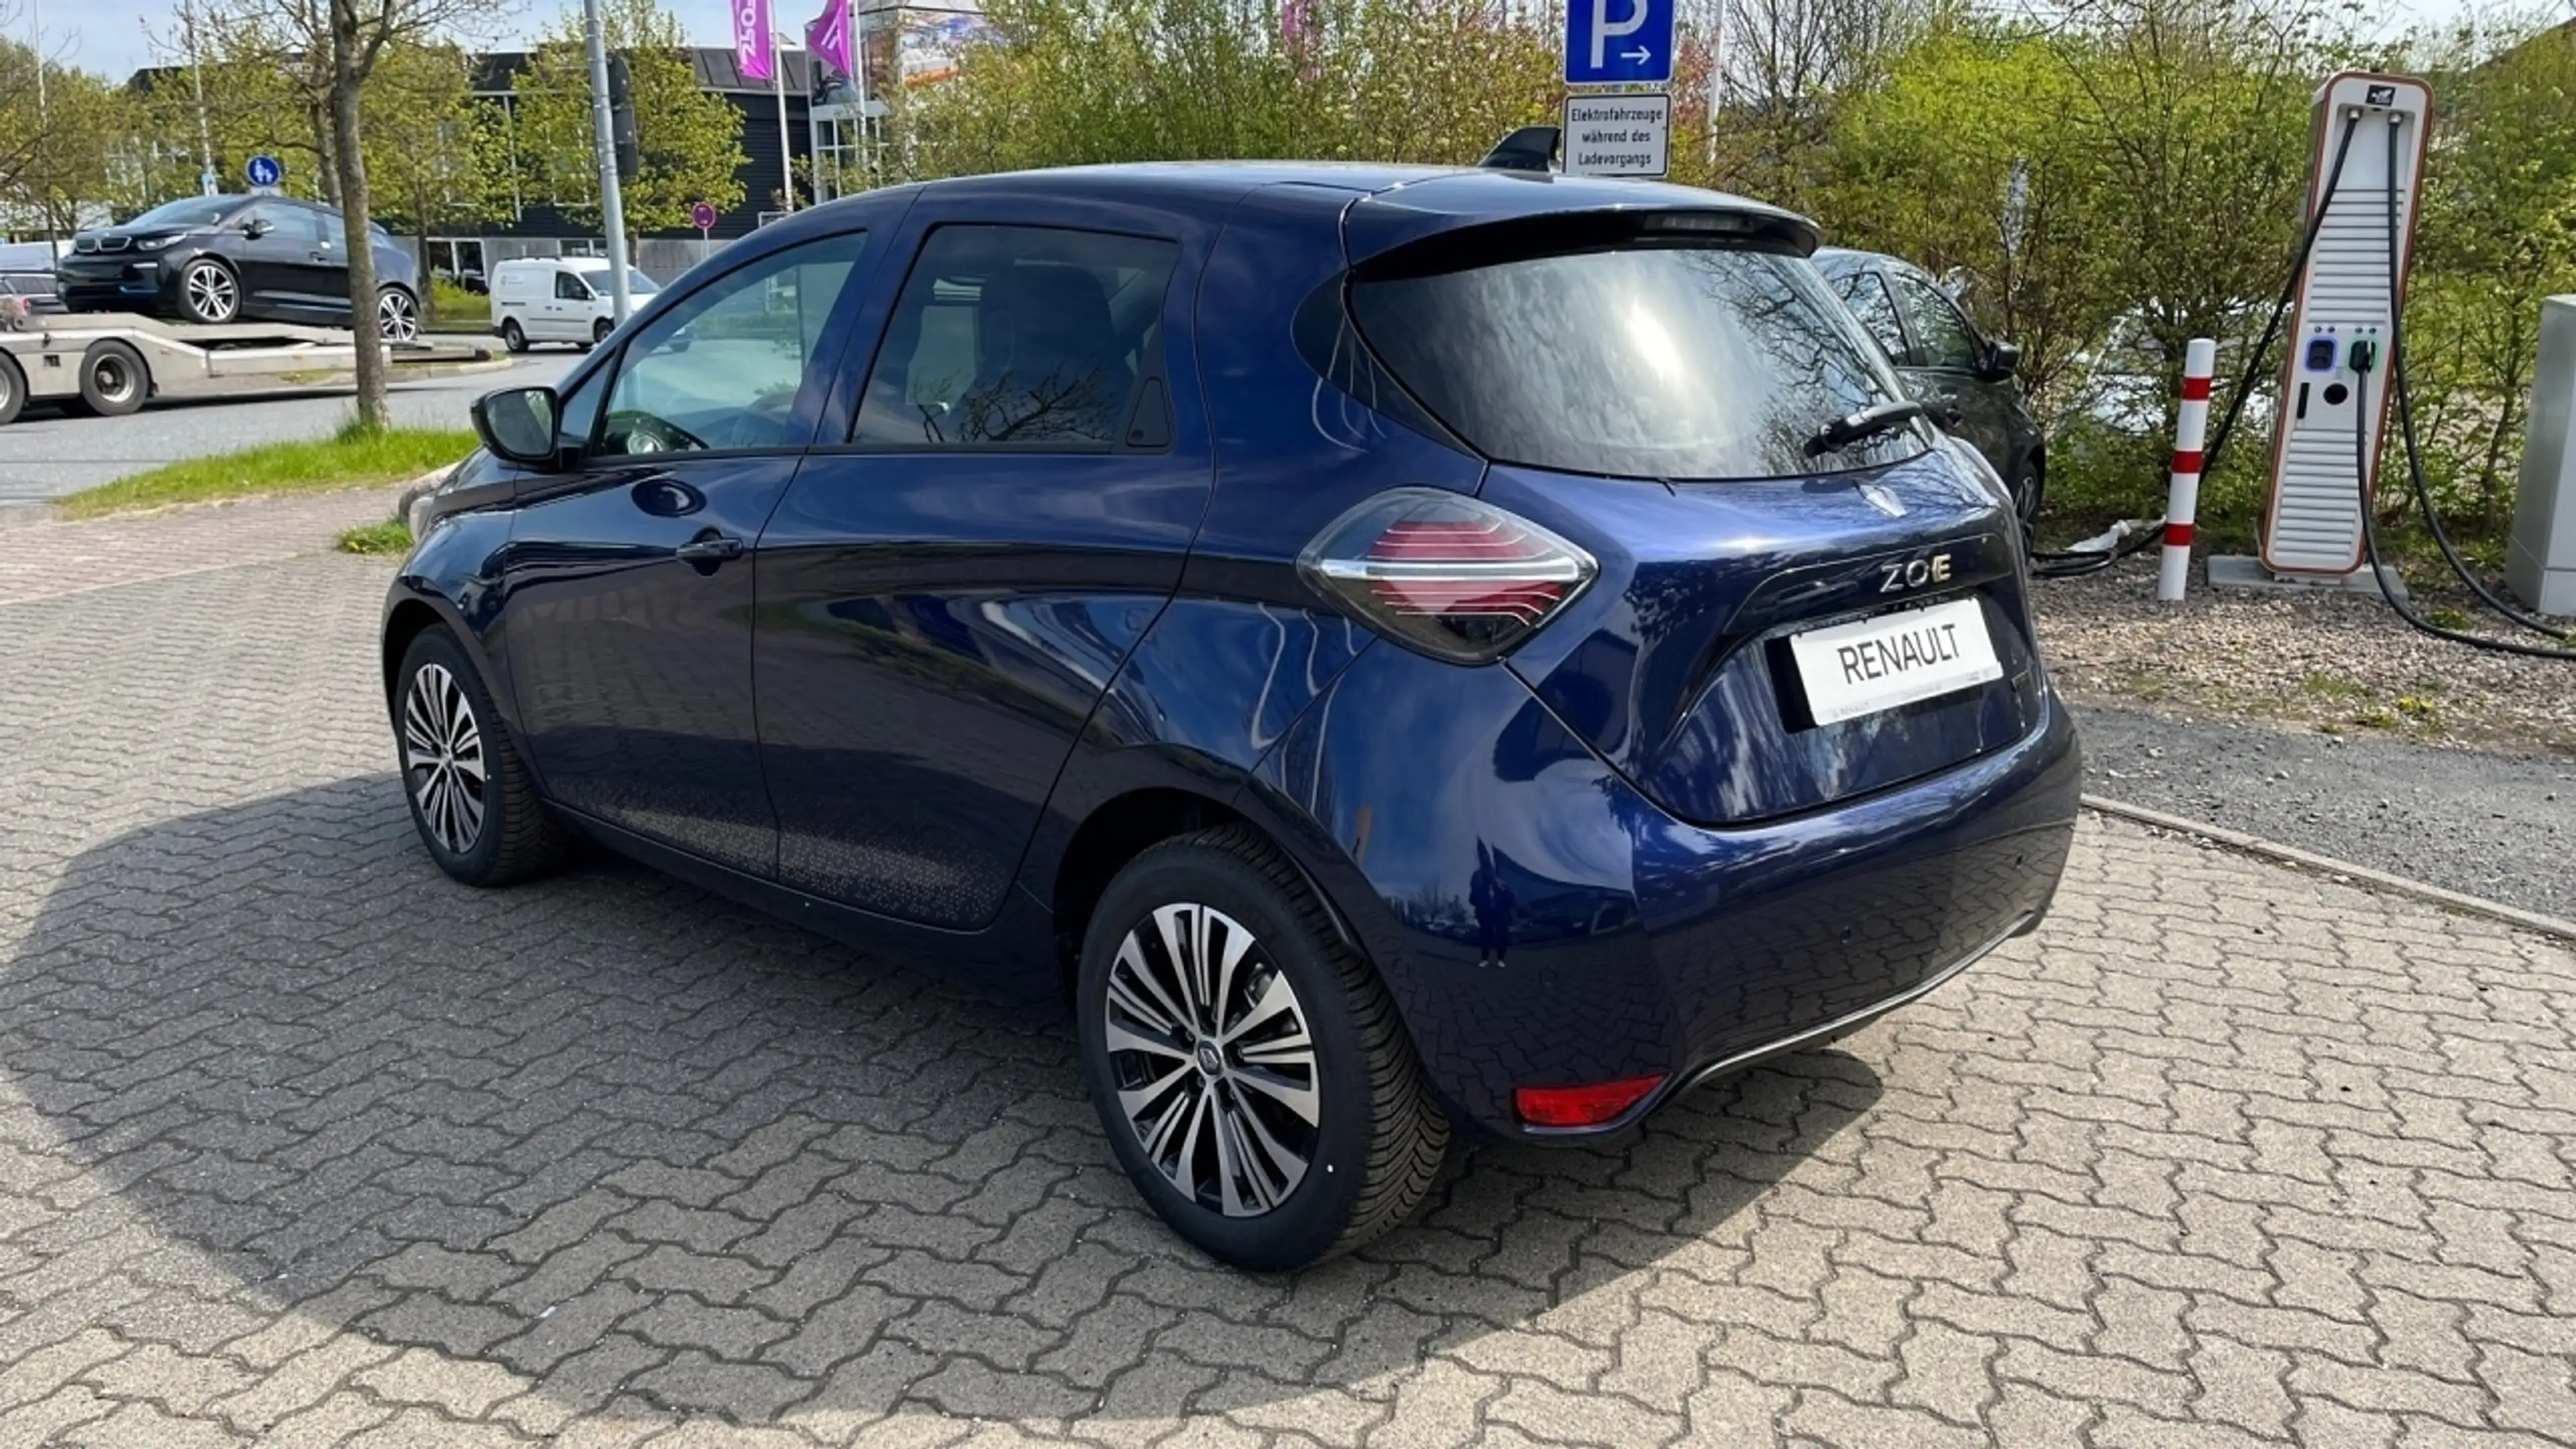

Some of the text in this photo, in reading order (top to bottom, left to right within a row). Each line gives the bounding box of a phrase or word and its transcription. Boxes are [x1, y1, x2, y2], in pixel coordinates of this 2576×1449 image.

[1591, 0, 1648, 68] P
[1571, 107, 1663, 123] Elektrofahrzeuge
[1582, 129, 1651, 143] während des
[1578, 152, 1652, 168] Ladevorgangs
[1880, 553, 1951, 592] ZOE
[1837, 623, 1959, 684] RENAULT
